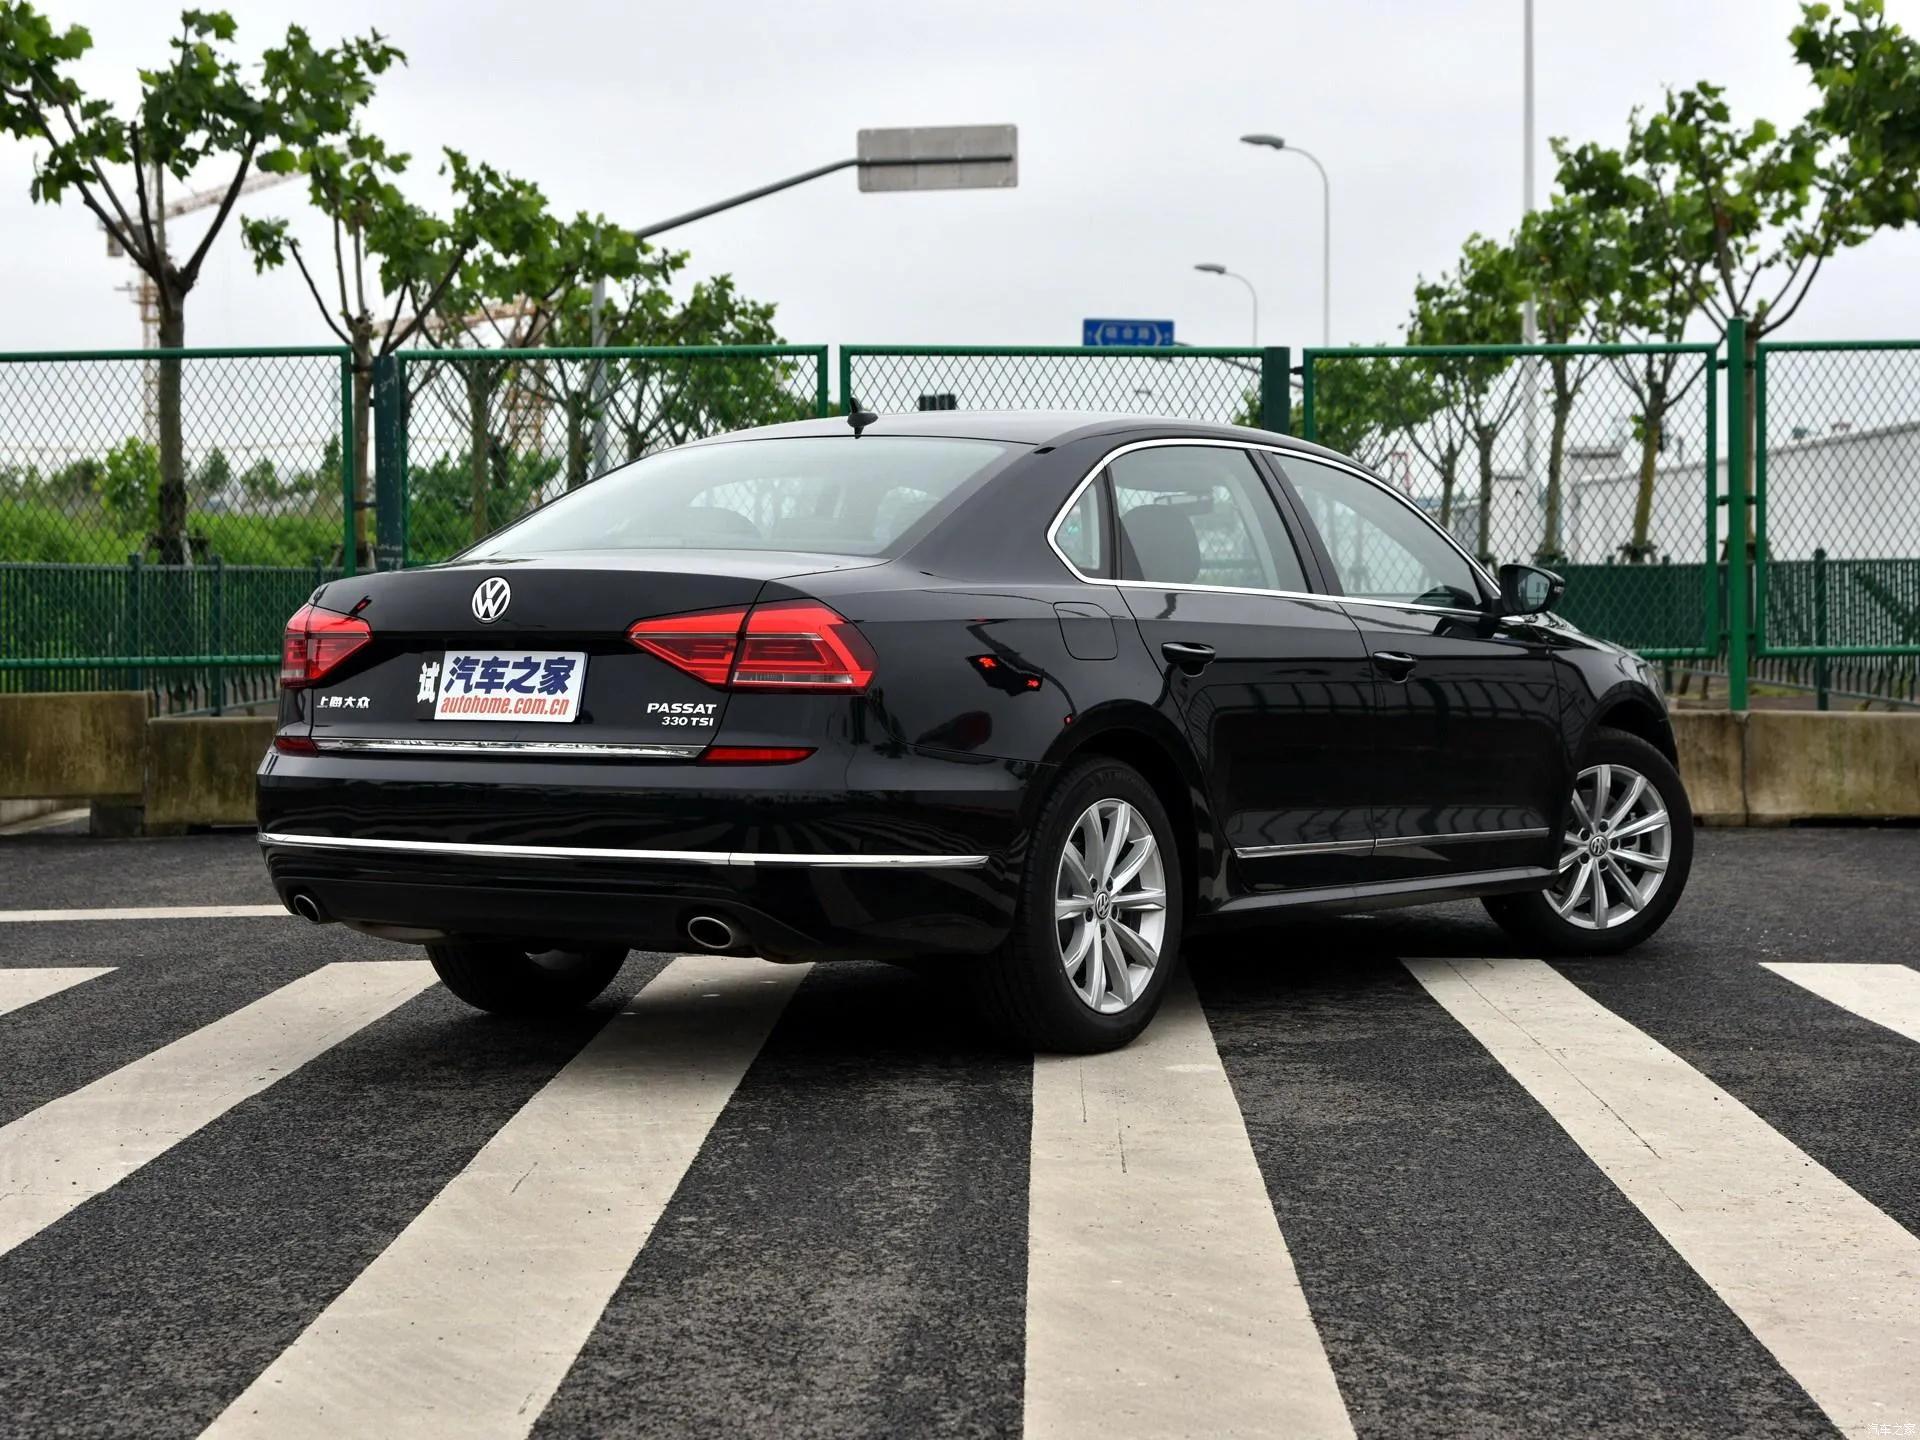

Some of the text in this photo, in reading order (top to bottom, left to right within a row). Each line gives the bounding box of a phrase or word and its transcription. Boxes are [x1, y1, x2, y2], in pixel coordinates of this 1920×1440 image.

[472, 577, 511, 621] VW
[416, 661, 440, 704] 试
[444, 656, 576, 695] 汽车之家
[440, 696, 570, 716] autohome.com.cn
[647, 703, 717, 714] PASSAT
[661, 716, 714, 727] 330 TSI
